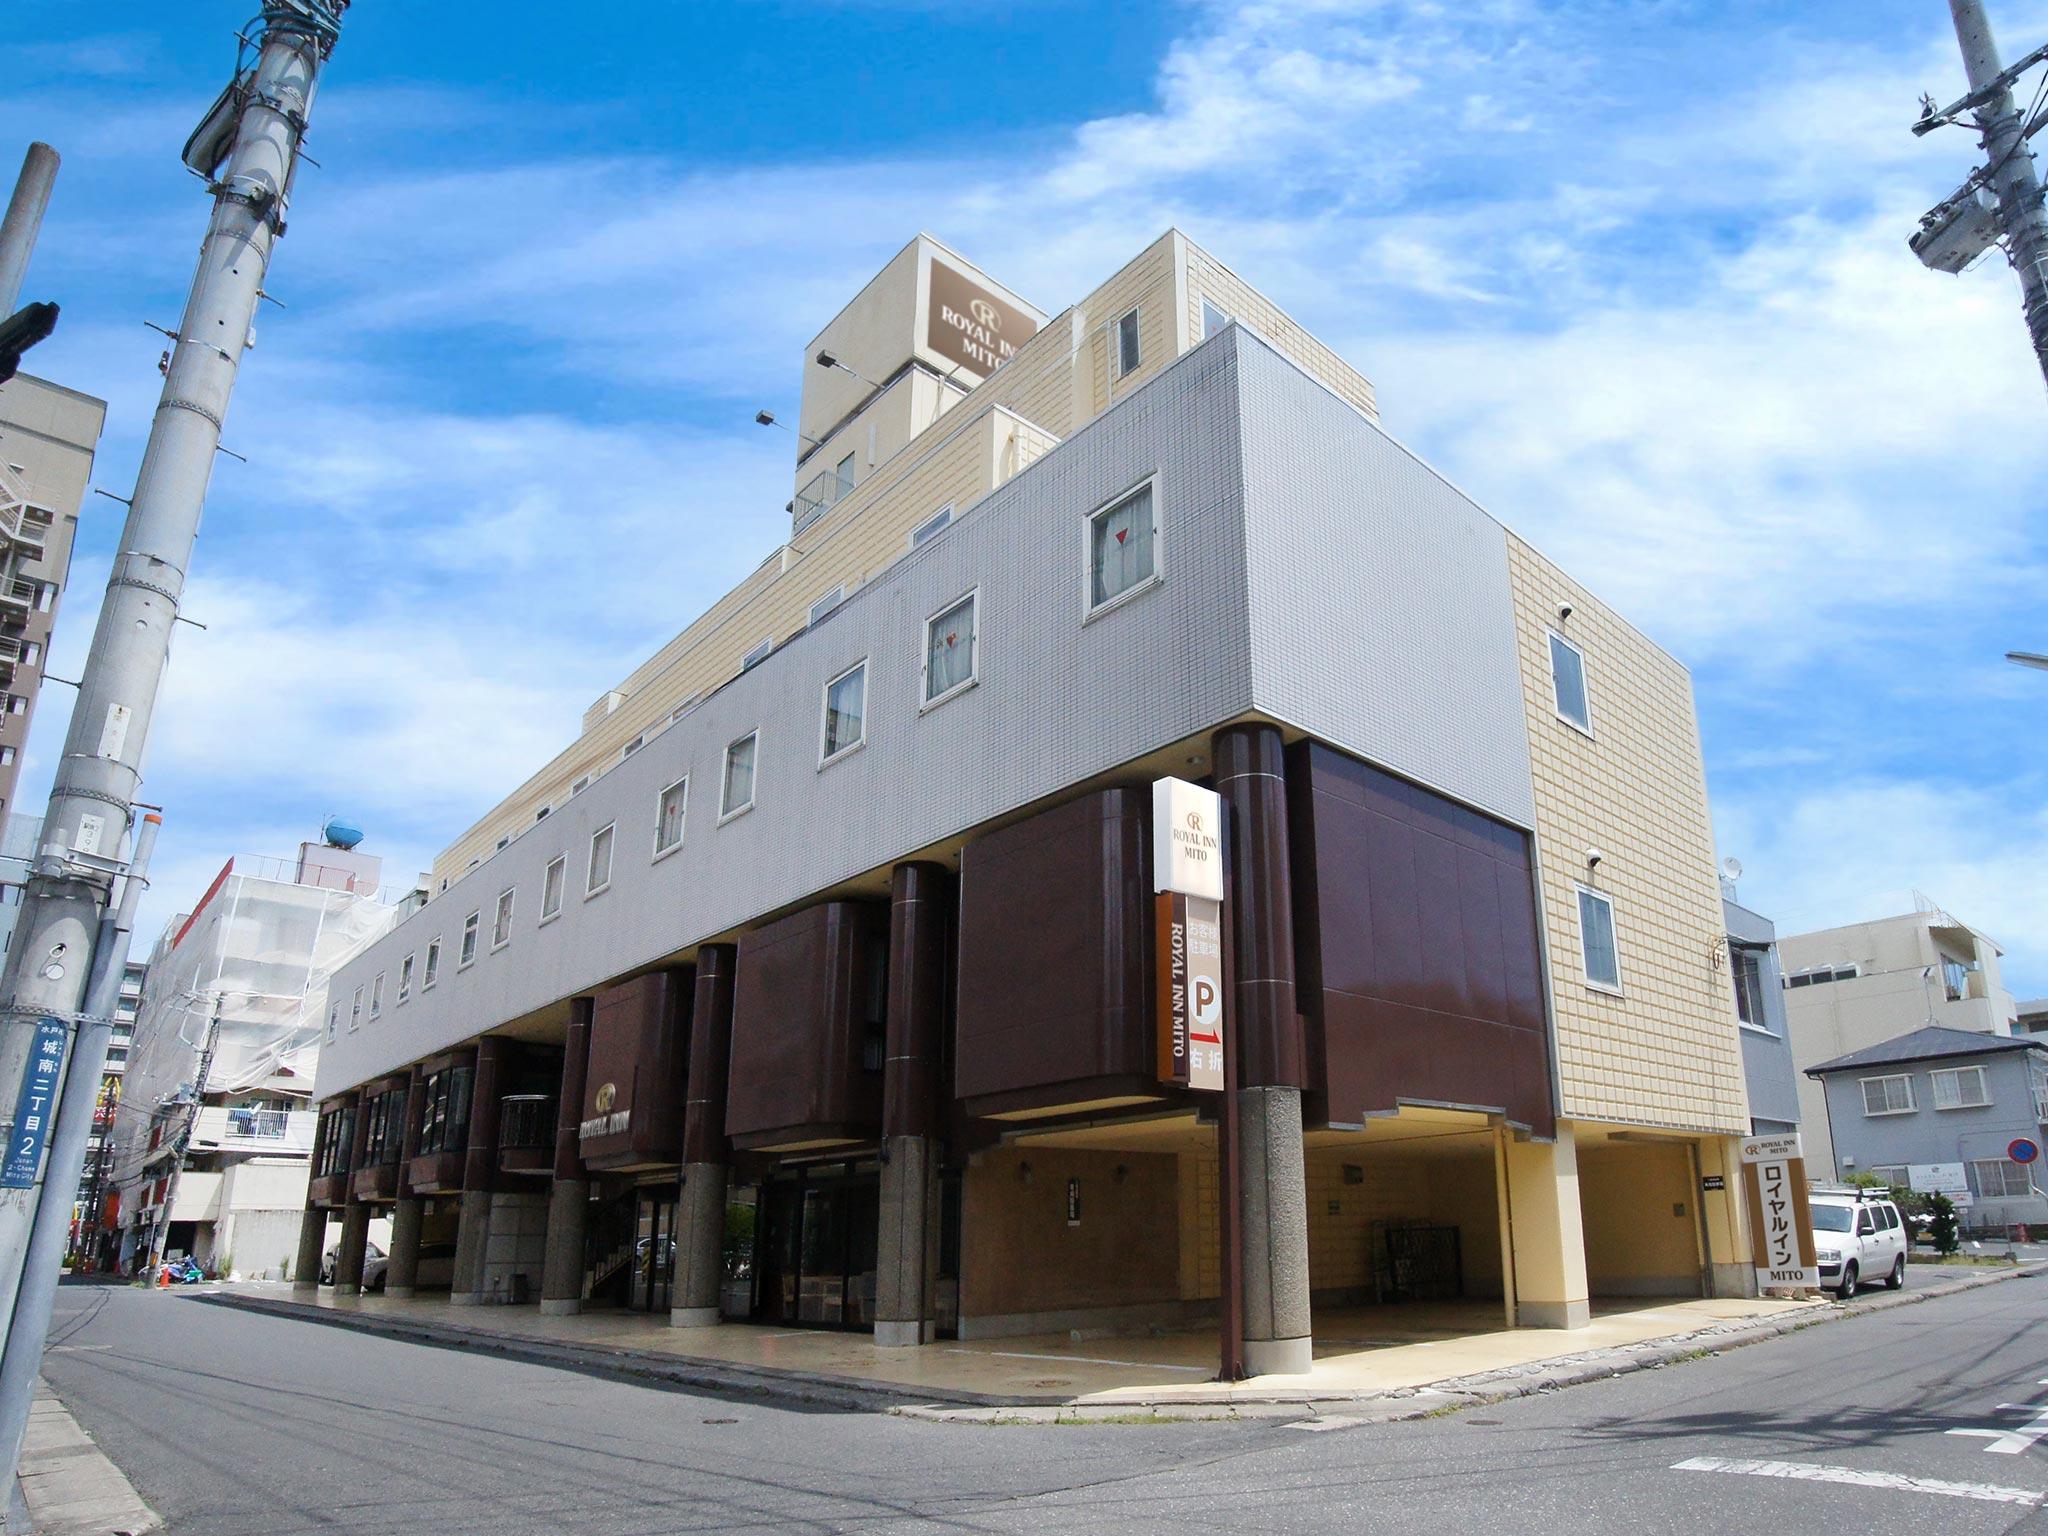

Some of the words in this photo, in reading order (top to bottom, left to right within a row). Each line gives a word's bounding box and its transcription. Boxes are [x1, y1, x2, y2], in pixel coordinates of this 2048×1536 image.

[942, 305, 994, 348] ROYAL
[1000, 339, 1016, 357] IN
[1173, 828, 1200, 845] ROYAL
[1203, 835, 1216, 848] INN
[1185, 846, 1207, 861] MITO
[1172, 921, 1184, 978] ROYAL
[1173, 984, 1184, 1012] INN
[1196, 981, 1214, 1016] P
[1173, 1015, 1184, 1057] MITO
[24, 1039, 58, 1131] 城南二丁目
[579, 1116, 608, 1140] ROYAL
[609, 1109, 631, 1135] INN
[20, 1136, 34, 1154] 2
[1761, 1140, 1783, 1148] ROYAL
[1765, 1165, 1791, 1266] ロイヤルイン
[1770, 1271, 1804, 1281] MITO
